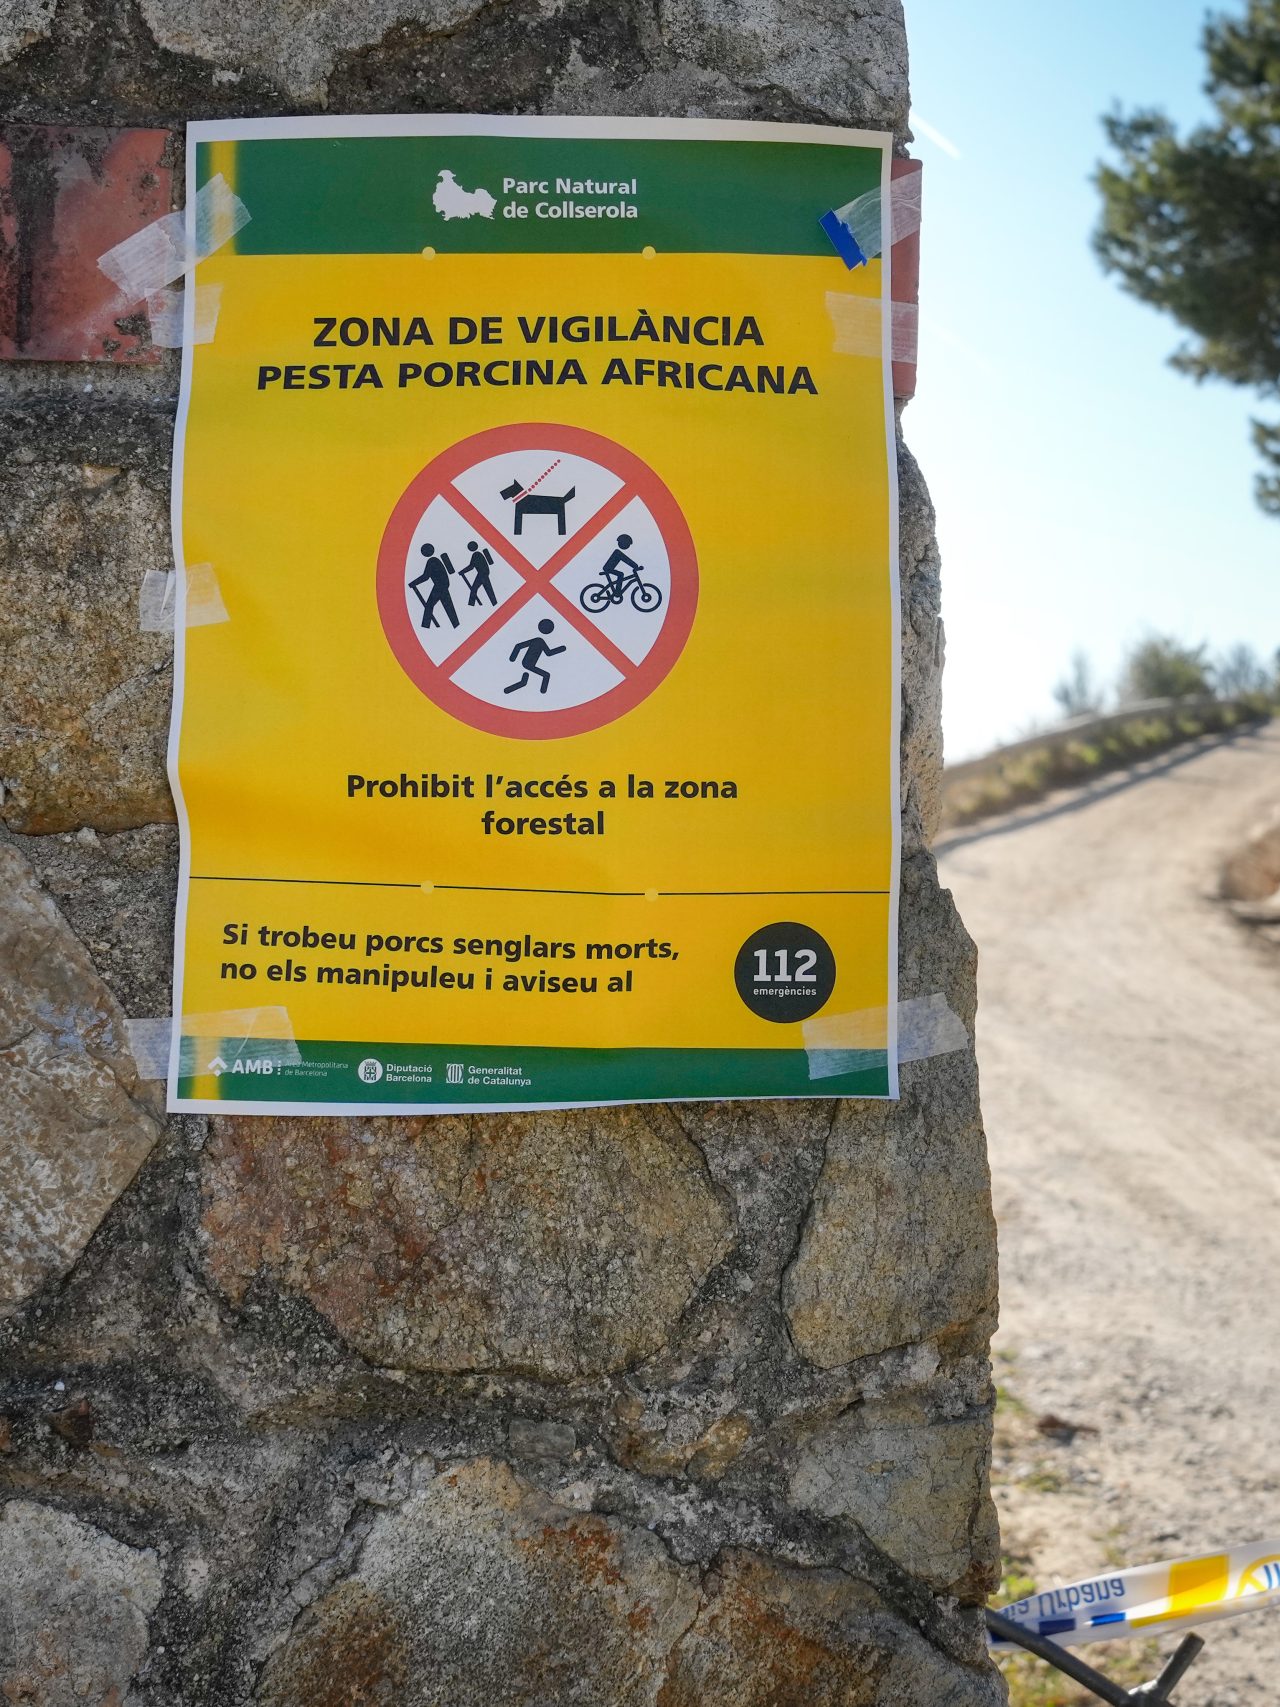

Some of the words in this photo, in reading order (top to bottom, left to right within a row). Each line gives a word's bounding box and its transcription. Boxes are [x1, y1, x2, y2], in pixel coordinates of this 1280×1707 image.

[503, 177, 549, 194] Parc
[555, 178, 637, 195] Natural
[502, 200, 529, 219] de
[535, 200, 638, 219] Collserola
[313, 316, 434, 348] ZONA
[448, 316, 503, 345] DE
[517, 308, 765, 347] VIGILÀNCIA
[257, 363, 384, 391] PESTA
[398, 358, 588, 388] PORCINA
[600, 357, 819, 395] AFRICANA
[347, 773, 475, 799] Prohibit
[598, 780, 616, 799] a
[628, 773, 654, 799] la
[664, 780, 738, 799] zona
[481, 810, 605, 836] forestal
[222, 923, 249, 946] Si
[257, 925, 356, 950] trobeu
[365, 934, 444, 957] porcs
[452, 934, 576, 963] senglars
[586, 938, 680, 962] morts,
[753, 949, 817, 982] 112
[220, 962, 257, 982] no
[266, 959, 307, 984] els
[316, 963, 475, 993] manipuleu
[485, 967, 493, 991] i
[502, 969, 598, 993] aviseu
[607, 970, 633, 993] al
[753, 986, 817, 998] emergències
[231, 1059, 274, 1075] AMB
[295, 1069, 328, 1077] Barcelona
[302, 1061, 349, 1069] Metropolitana
[386, 1063, 433, 1073] Diputació
[468, 1065, 523, 1076] Generalitat
[386, 1073, 433, 1083] Barcelona
[467, 1076, 480, 1085] de
[482, 1076, 532, 1087] Catalunya
